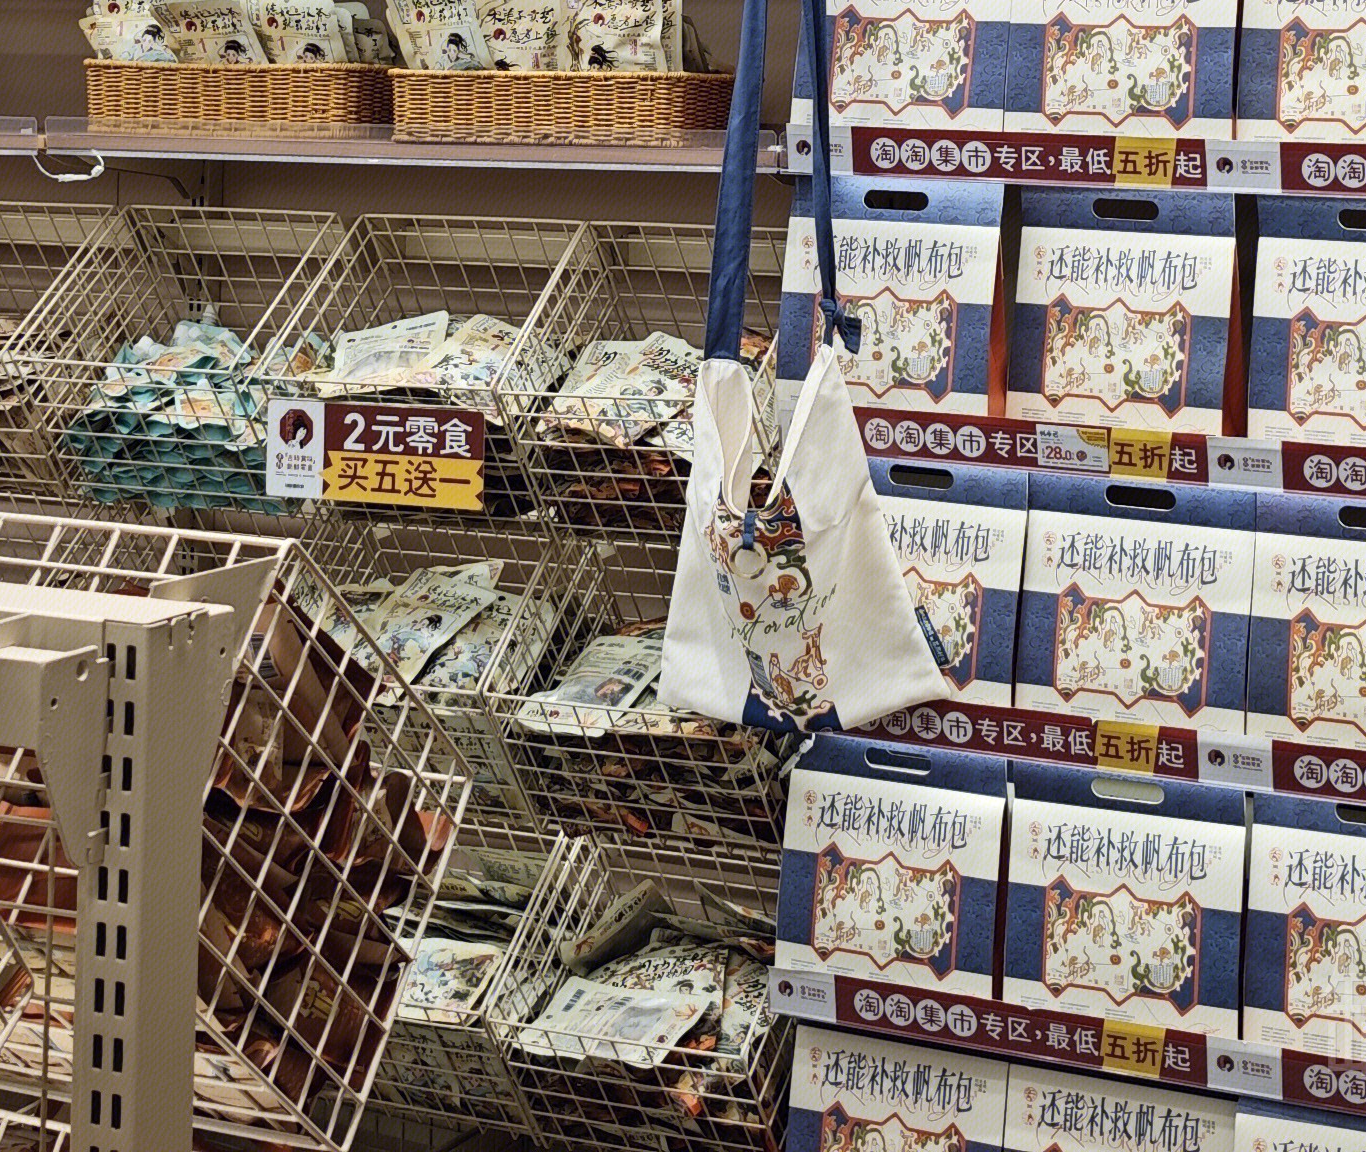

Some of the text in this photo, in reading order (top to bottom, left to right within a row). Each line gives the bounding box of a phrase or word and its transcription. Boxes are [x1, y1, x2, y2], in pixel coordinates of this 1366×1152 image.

[1047, 245, 1200, 292] 还能补救帆布包
[343, 412, 472, 457] 2元零食
[1112, 441, 1198, 473] 五折起
[338, 456, 471, 498] 买五送一
[1057, 531, 1219, 586] 还能补救帆布包
[817, 791, 969, 849] 还能补救帆布包
[1043, 821, 1208, 879] 还能补救帆布包
